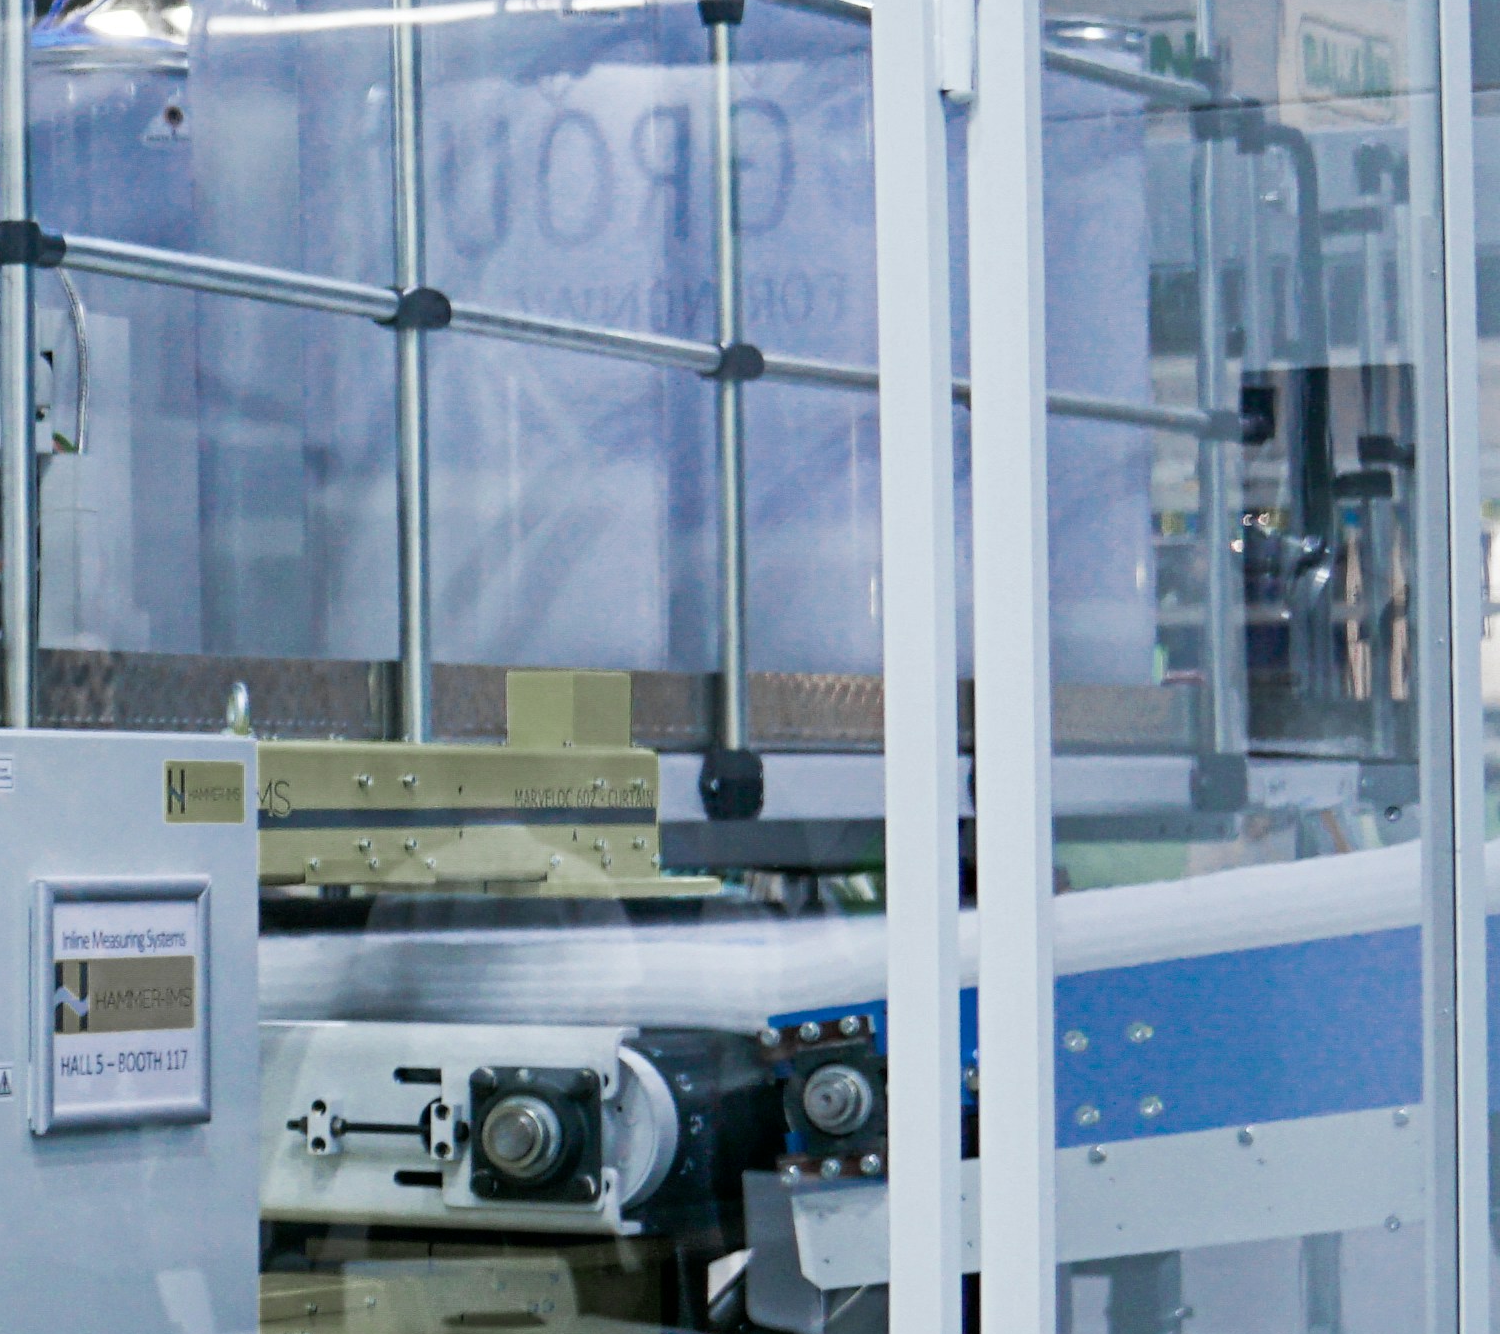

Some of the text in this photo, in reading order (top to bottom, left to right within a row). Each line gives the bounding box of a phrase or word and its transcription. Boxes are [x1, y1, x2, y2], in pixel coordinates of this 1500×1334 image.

[608, 788, 654, 808] CURTAIN
[62, 928, 186, 953] Inline Measuring Systems
[95, 987, 193, 1011] HAMMER-IMS
[61, 1054, 93, 1076] HALL
[96, 1053, 104, 1075] 5
[118, 1051, 162, 1073] BOOTH
[167, 1049, 188, 1071] 117
